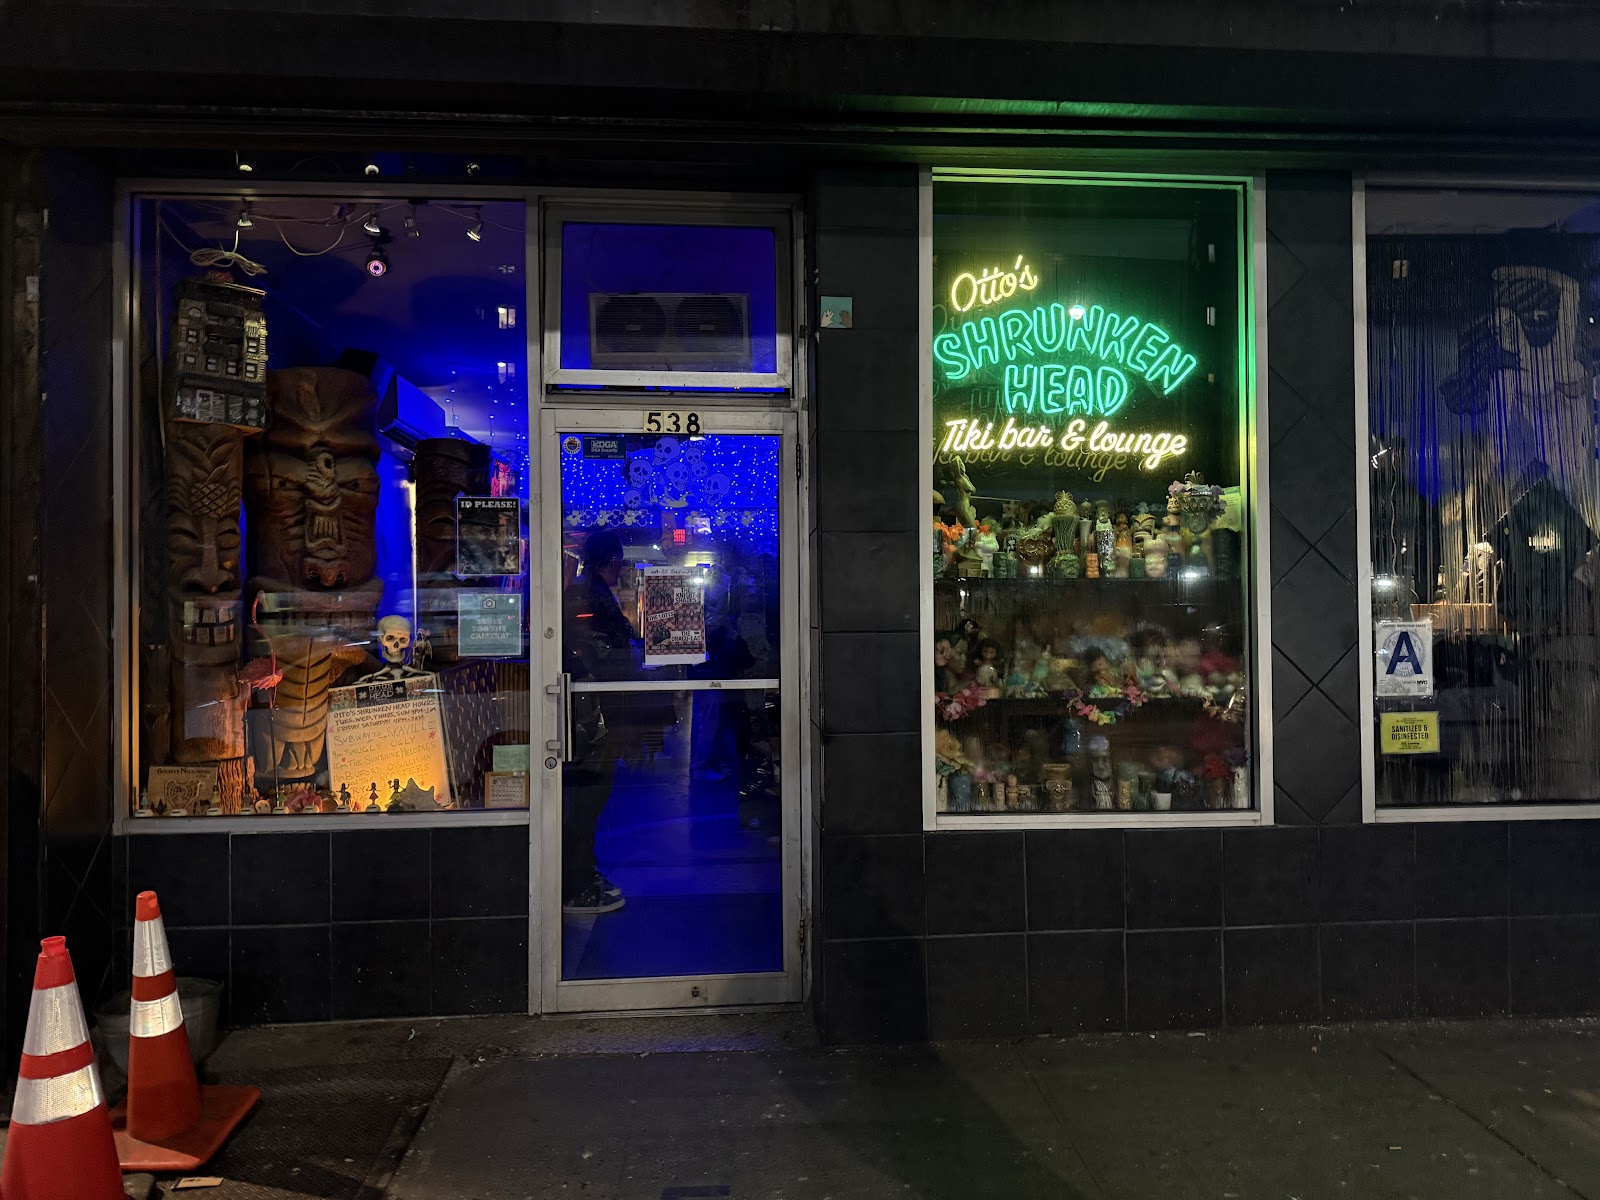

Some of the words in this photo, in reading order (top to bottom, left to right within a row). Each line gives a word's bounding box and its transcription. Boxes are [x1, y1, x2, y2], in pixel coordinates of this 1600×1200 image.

[951, 255, 1038, 312] Otto's
[934, 303, 1197, 395] SHRUNKEN
[1004, 364, 1128, 416] HEAD
[647, 413, 700, 433] 538
[943, 418, 994, 452] Tiki
[998, 418, 1053, 450] bar
[1061, 419, 1086, 451] &
[1090, 421, 1187, 470] lounge
[1386, 632, 1423, 674] A
[370, 690, 394, 700] HEAD
[333, 710, 356, 719] OTTO'S
[356, 705, 392, 716] SHRUNKEN
[392, 702, 411, 711] HEAD
[412, 699, 435, 708] HOURS
[396, 709, 410, 717] SUN
[334, 732, 372, 747] SUBWAY
[387, 720, 436, 737] SKAVILLE
[1392, 732, 1429, 740] DISINFECTED
[345, 743, 383, 756] SMUGLY
[390, 736, 416, 747] UGLY
[347, 758, 362, 767] THE
[399, 741, 437, 758] MELODIES
[344, 767, 382, 781] BUFORD
